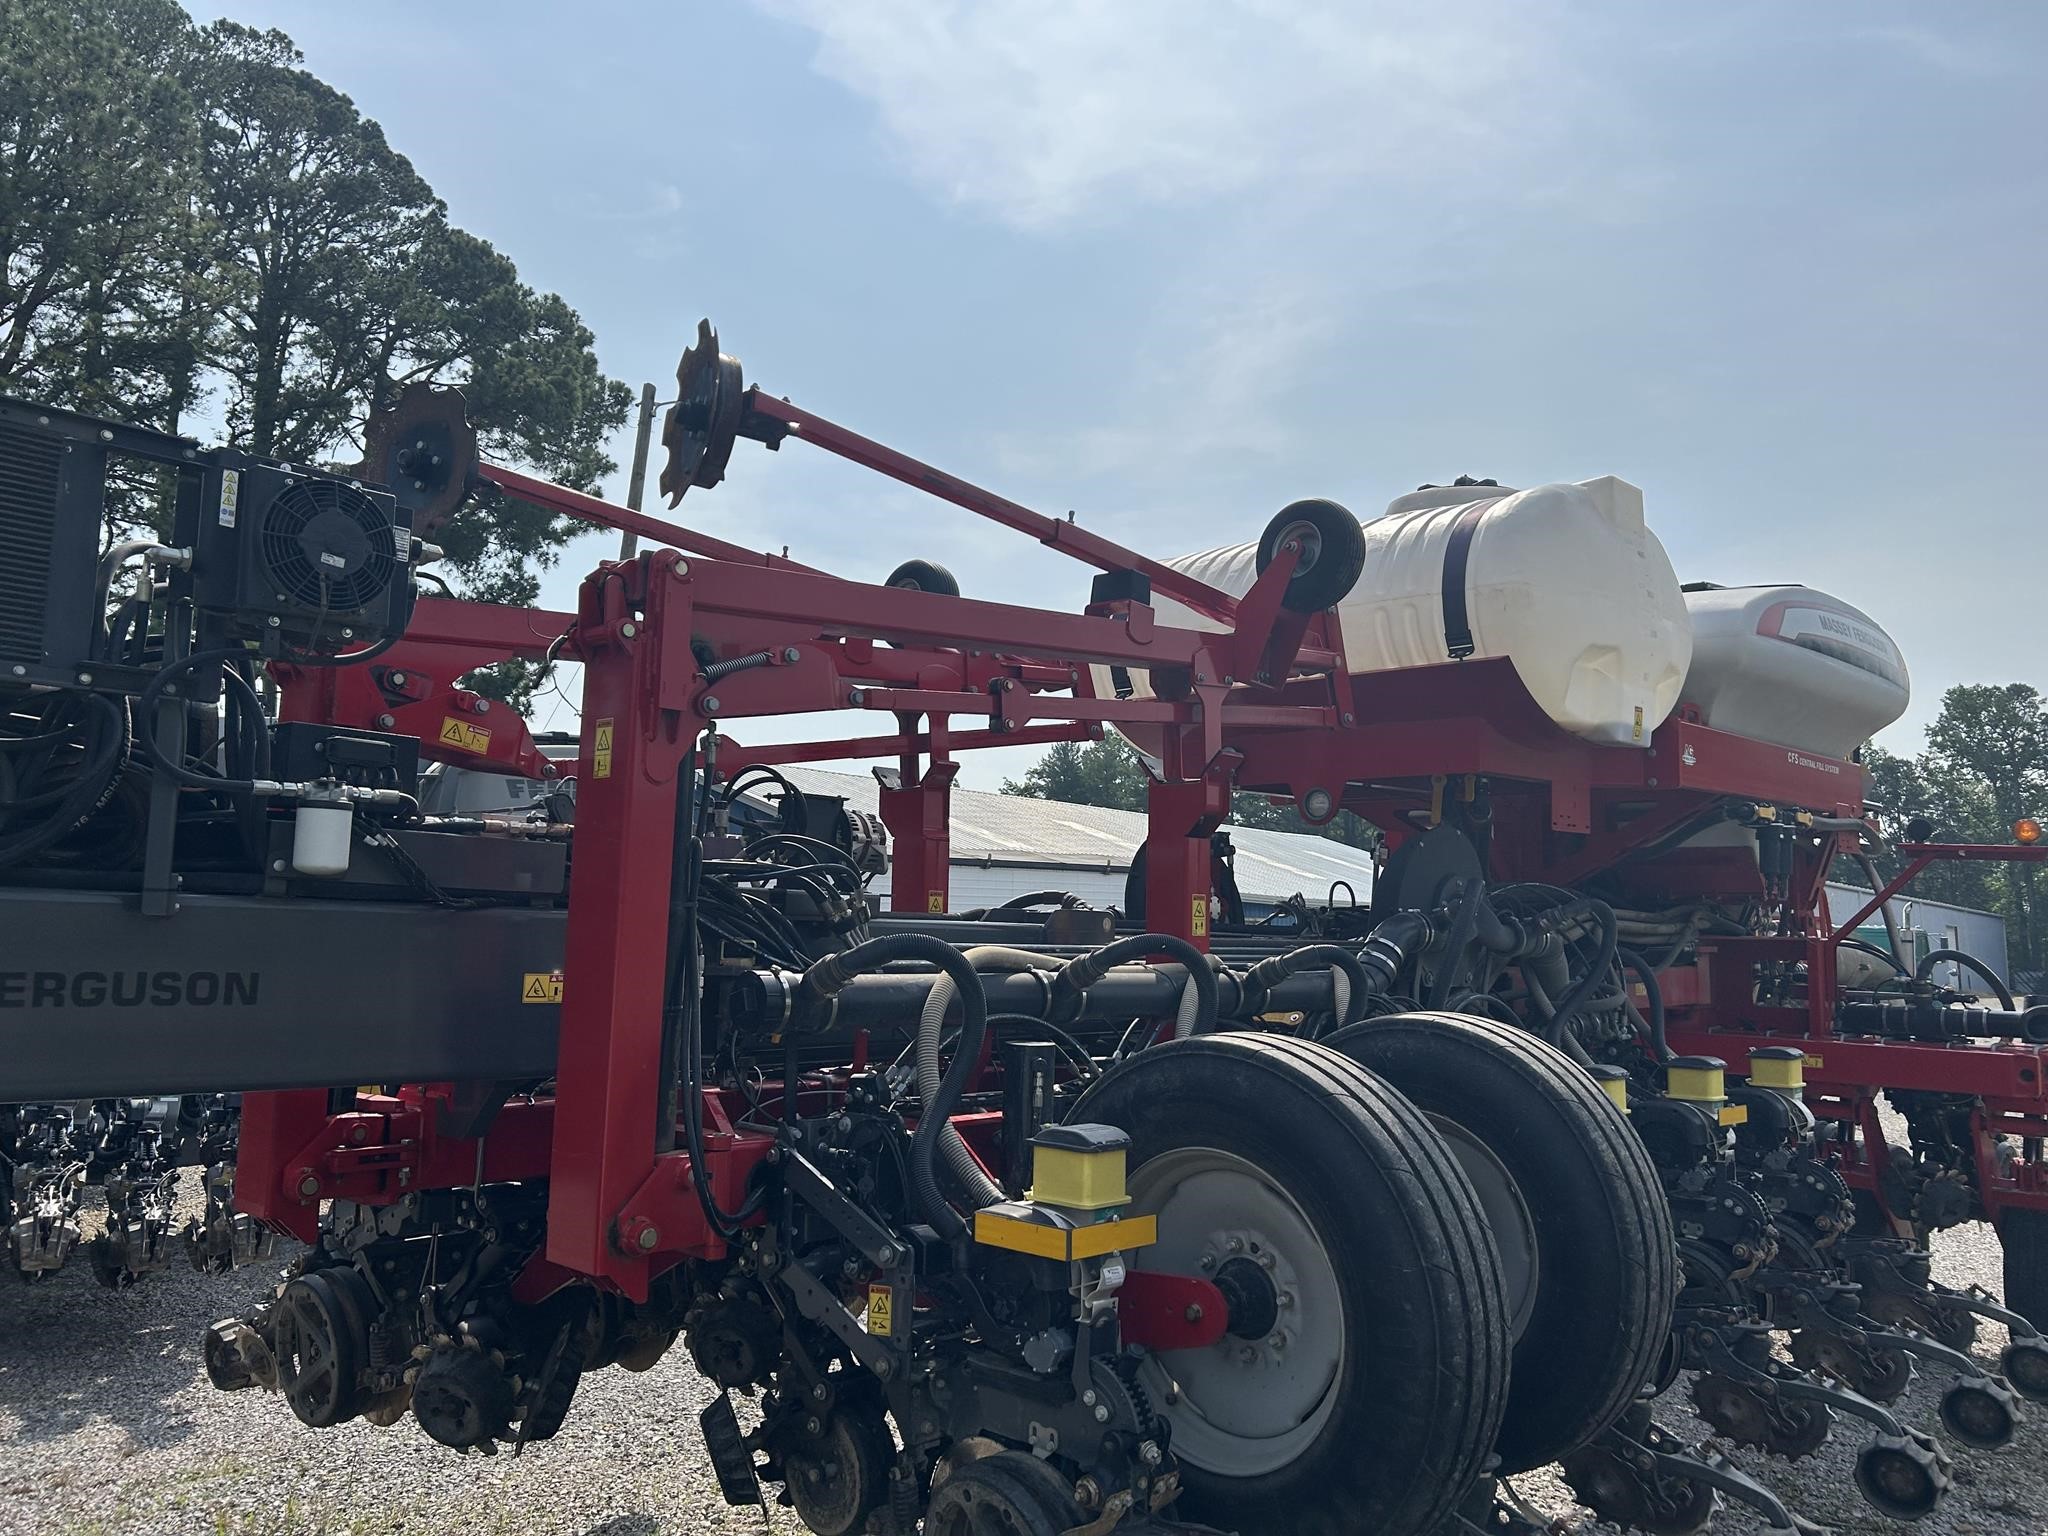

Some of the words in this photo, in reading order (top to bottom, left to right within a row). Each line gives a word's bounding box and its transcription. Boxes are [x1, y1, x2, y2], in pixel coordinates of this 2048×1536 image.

[1818, 614, 1852, 638] MASSEY
[1787, 752, 1799, 764] CFS
[0, 971, 260, 1008] ERGUSON
